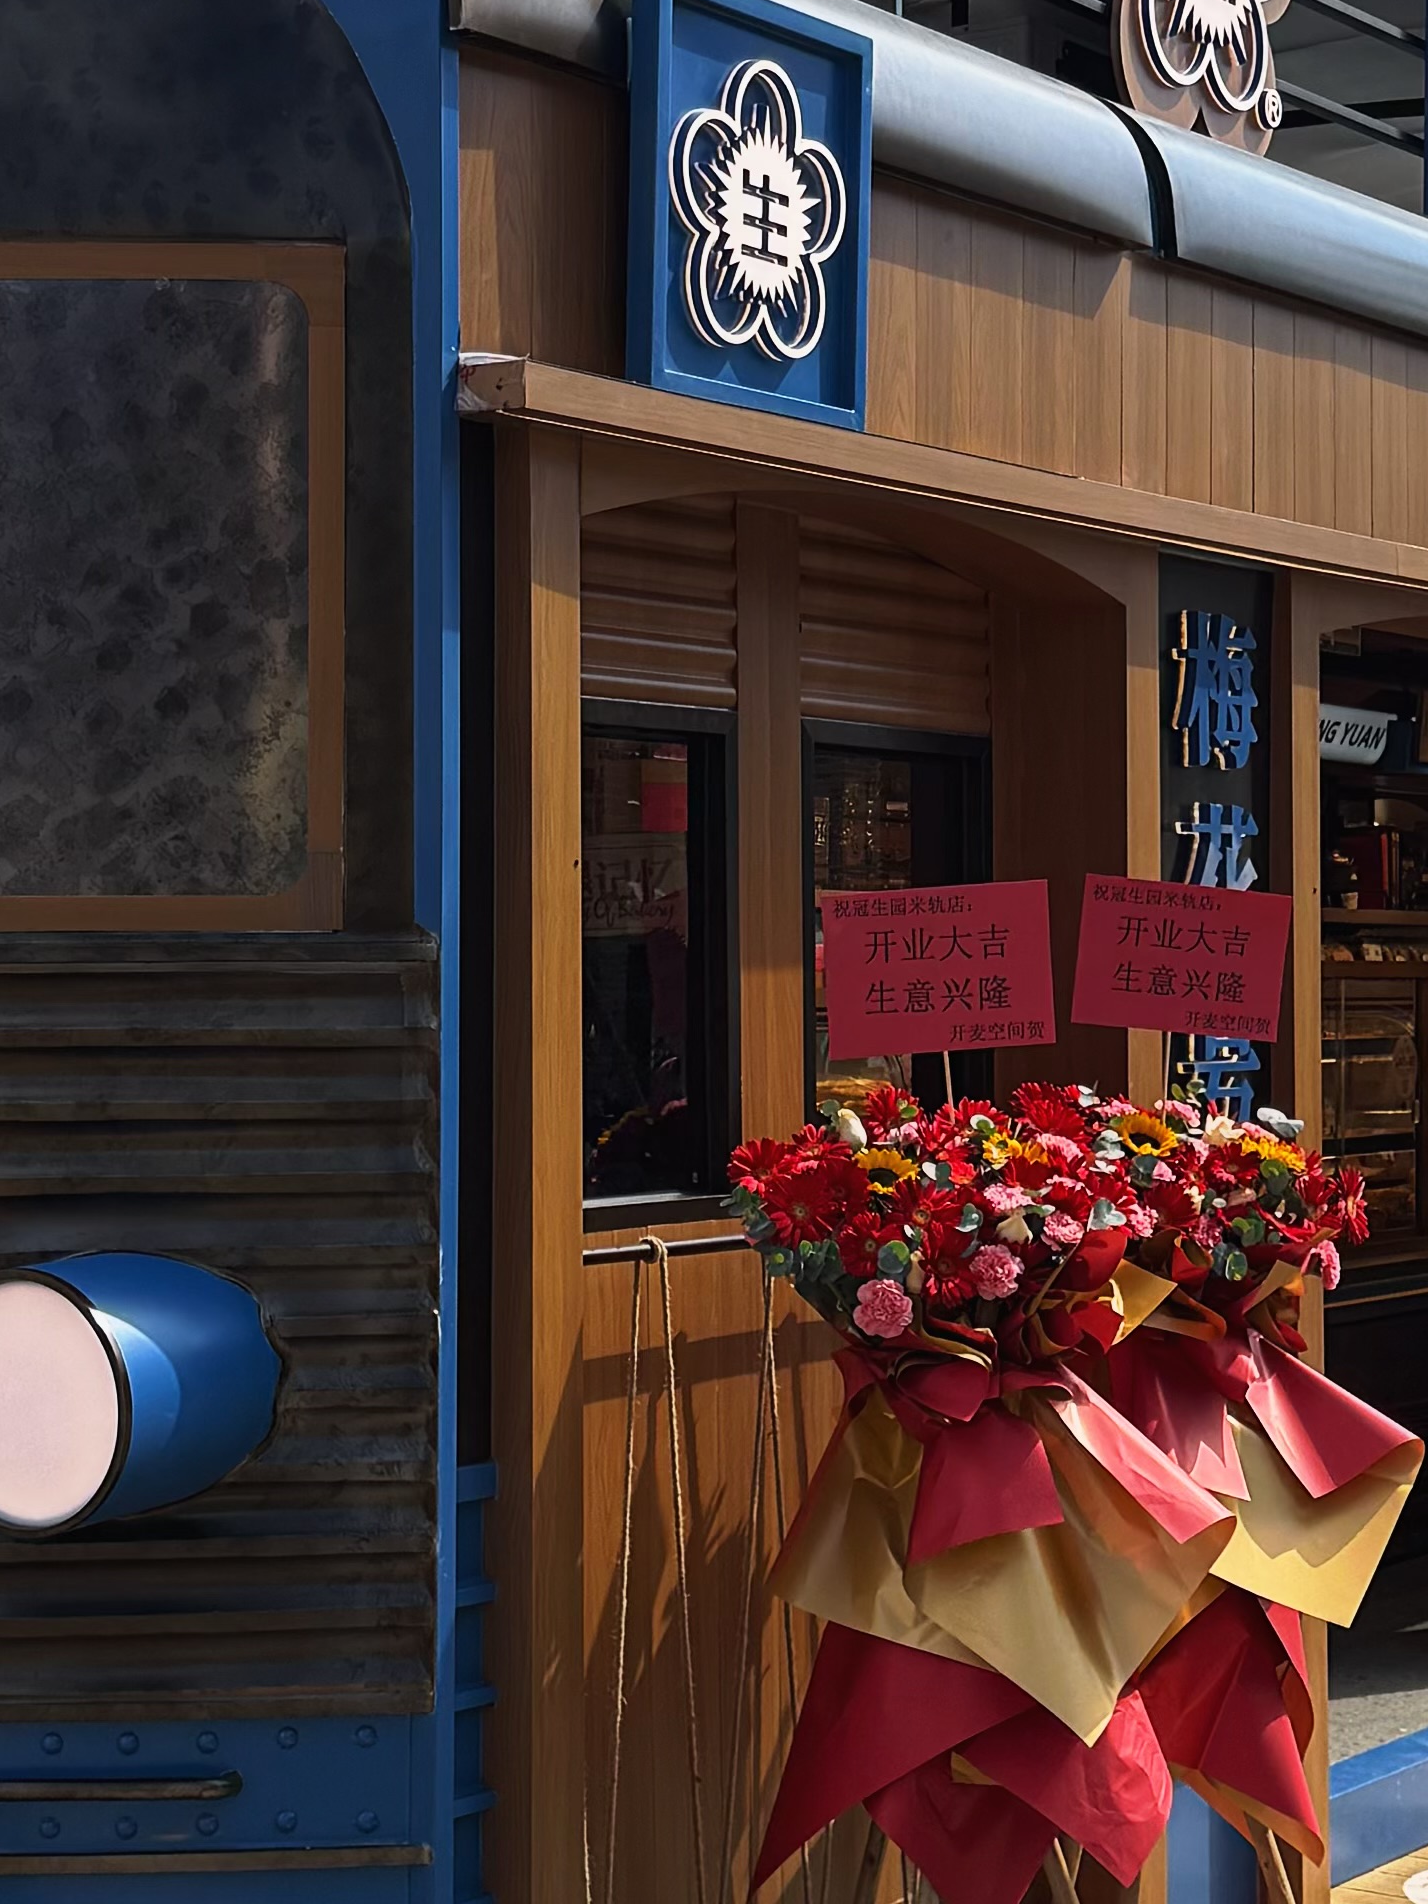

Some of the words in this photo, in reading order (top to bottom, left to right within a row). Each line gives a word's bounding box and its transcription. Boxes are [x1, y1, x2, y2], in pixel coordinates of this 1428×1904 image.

[1340, 721, 1386, 751] YUAN
[864, 923, 1010, 964] 开业大吉
[1117, 915, 1251, 957] 开业大吉
[865, 975, 1012, 1015] 生意兴隆
[1111, 961, 1246, 1004] 生意兴隆
[949, 1020, 1045, 1043] 开麦空间贺
